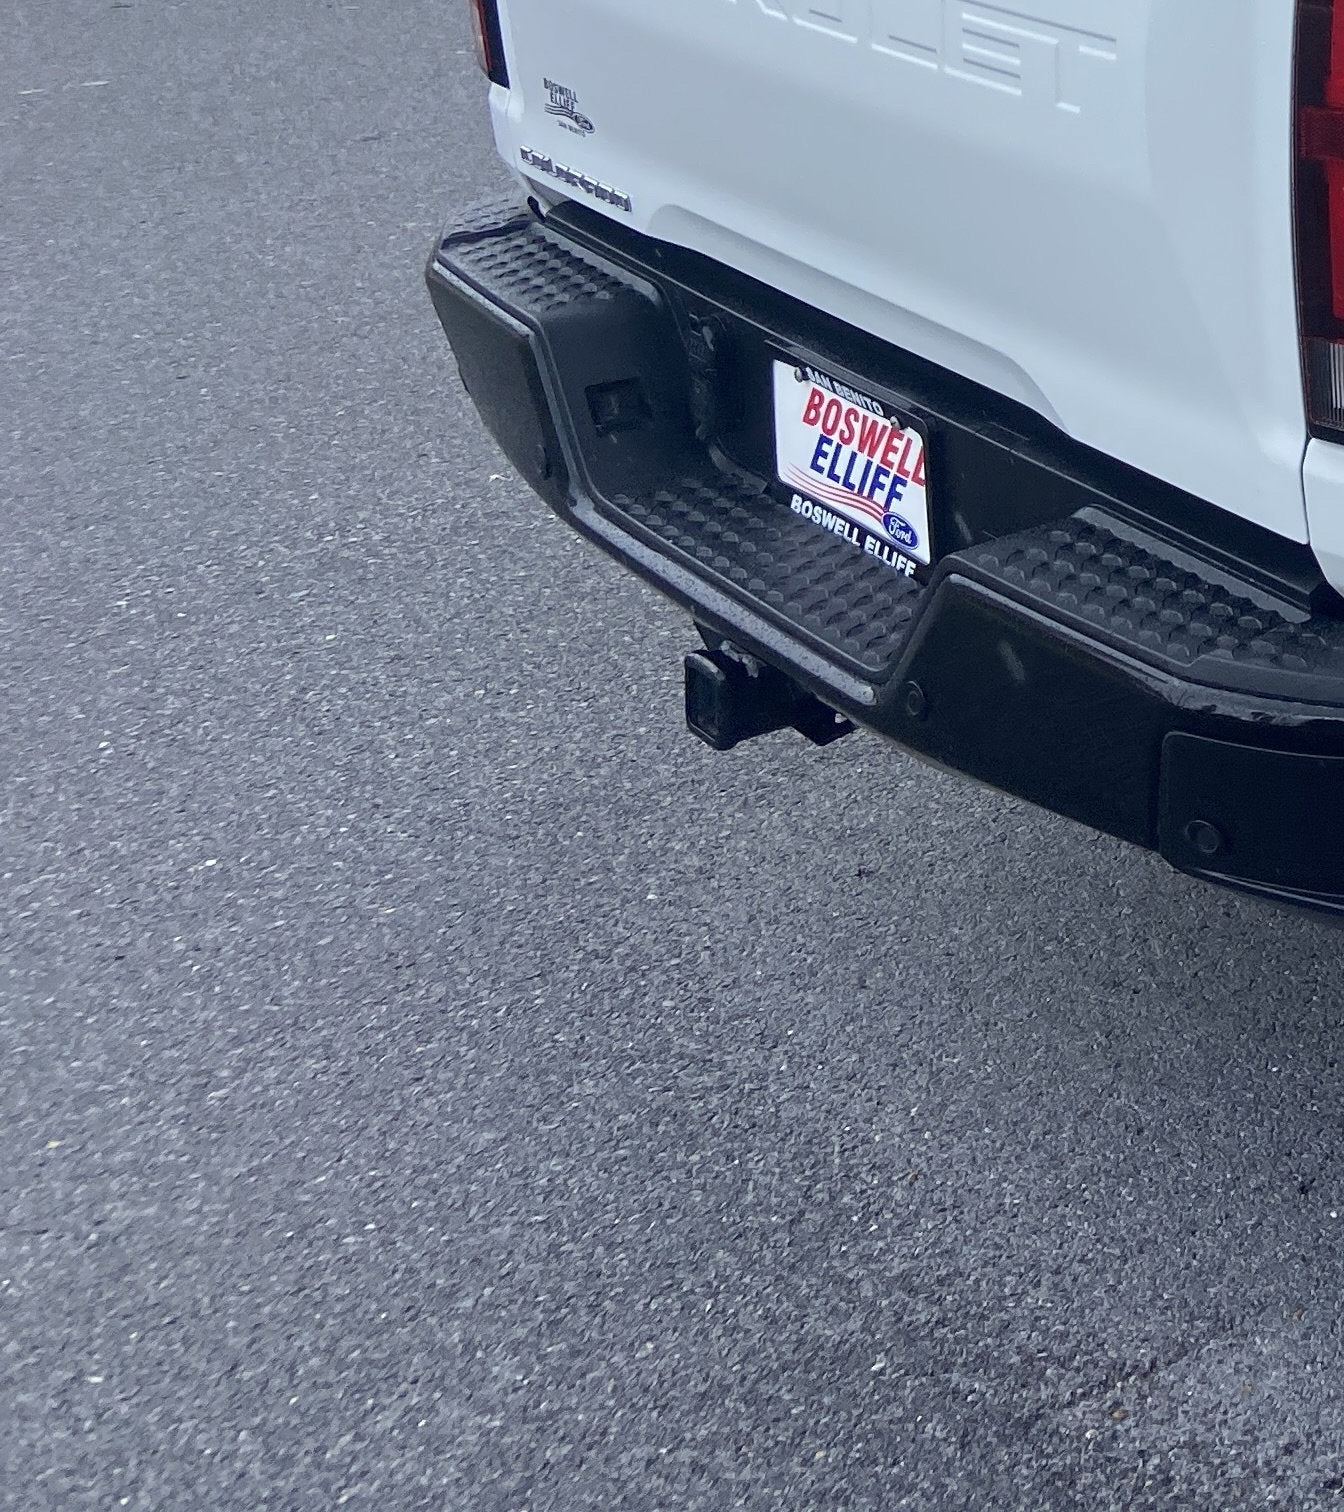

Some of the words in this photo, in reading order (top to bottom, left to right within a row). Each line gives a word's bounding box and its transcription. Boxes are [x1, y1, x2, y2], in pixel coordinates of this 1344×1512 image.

[806, 366, 832, 393] SAN
[836, 379, 884, 416] BENITO
[802, 386, 926, 487] BOSWELL
[809, 433, 908, 513] ELLIFF
[790, 493, 861, 547] BOSWELL
[864, 537, 917, 578] ELLIFF
[887, 515, 914, 545] Ford
